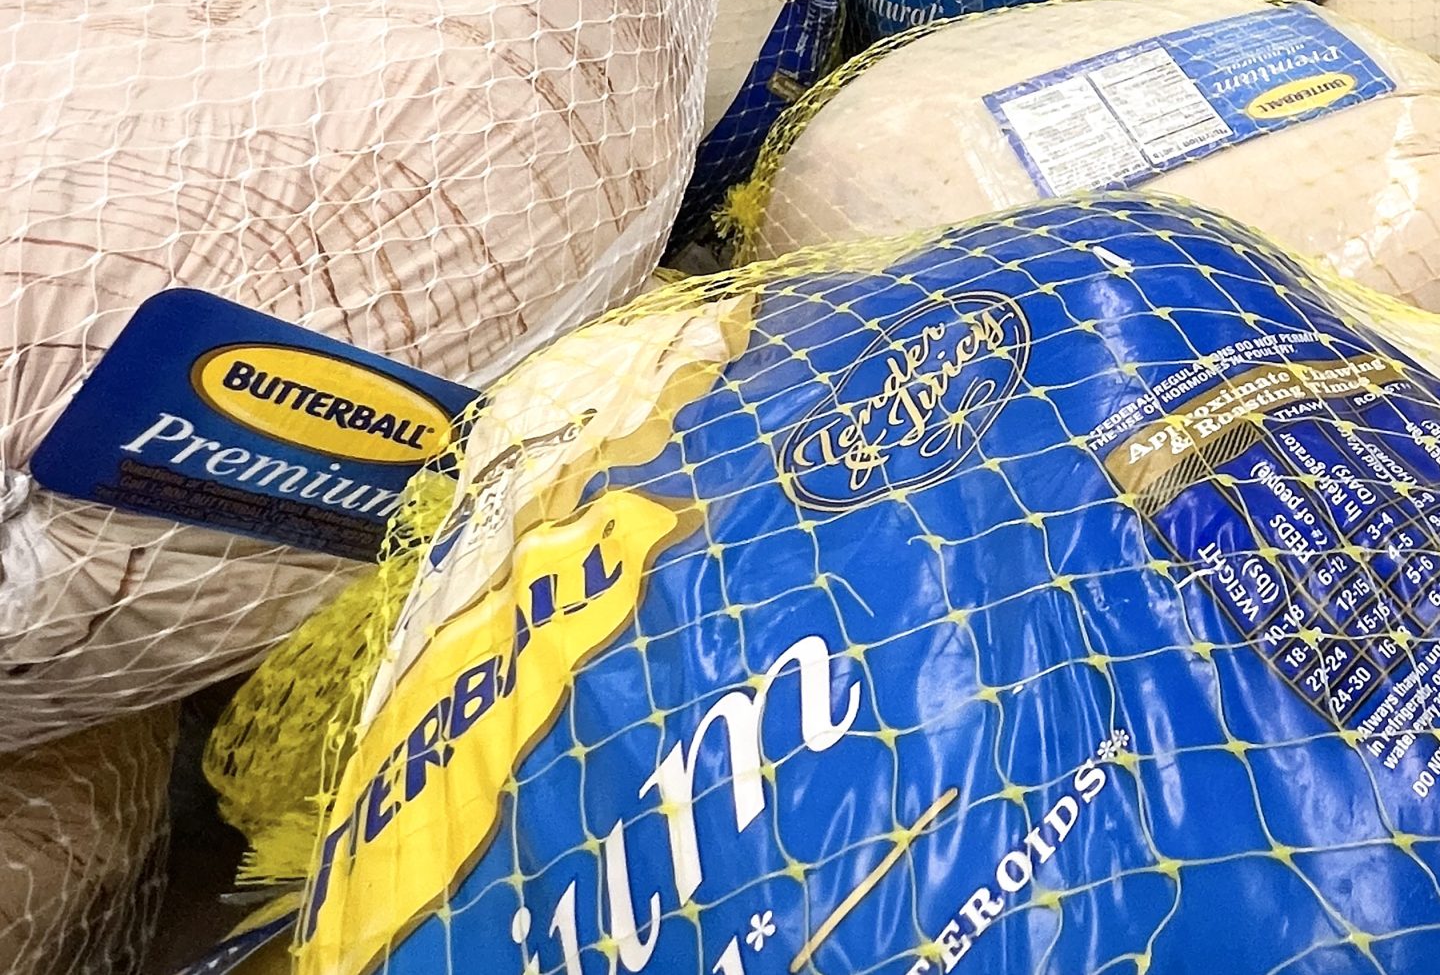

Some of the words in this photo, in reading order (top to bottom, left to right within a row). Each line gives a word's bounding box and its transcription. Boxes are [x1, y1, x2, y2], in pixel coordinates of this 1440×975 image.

[1212, 45, 1341, 95] Premium
[1259, 76, 1348, 114] BUTTERBALL
[1253, 334, 1278, 352] NOT
[1279, 330, 1321, 346] PERMIT
[793, 322, 945, 466] Tender
[888, 310, 1015, 447] Juicy
[222, 360, 426, 452] BUTTERBALL
[1128, 369, 1290, 465] Approximate
[1170, 435, 1194, 456] &
[1192, 380, 1306, 440] Roasting
[1274, 401, 1324, 422] THAW
[1089, 428, 1118, 452] THE
[1117, 411, 1144, 432] USE
[1333, 464, 1377, 505] (DAYS)
[1269, 514, 1315, 565] FEEDS
[1367, 512, 1394, 540] 3-4
[1388, 533, 1414, 560] 4-5
[1198, 541, 1260, 623] WEIGHT
[1242, 557, 1280, 604] (lbs)
[1318, 556, 1348, 586] 6-12
[1406, 556, 1434, 584] 5-6
[1336, 578, 1370, 612] 12-15
[1264, 604, 1305, 646] 10-18
[1357, 602, 1391, 635] 15-16
[1306, 646, 1348, 692] 22-24
[1331, 667, 1371, 713] 24-30
[1357, 693, 1398, 744] Always
[1384, 731, 1414, 771] water
[1412, 770, 1436, 800] DO
